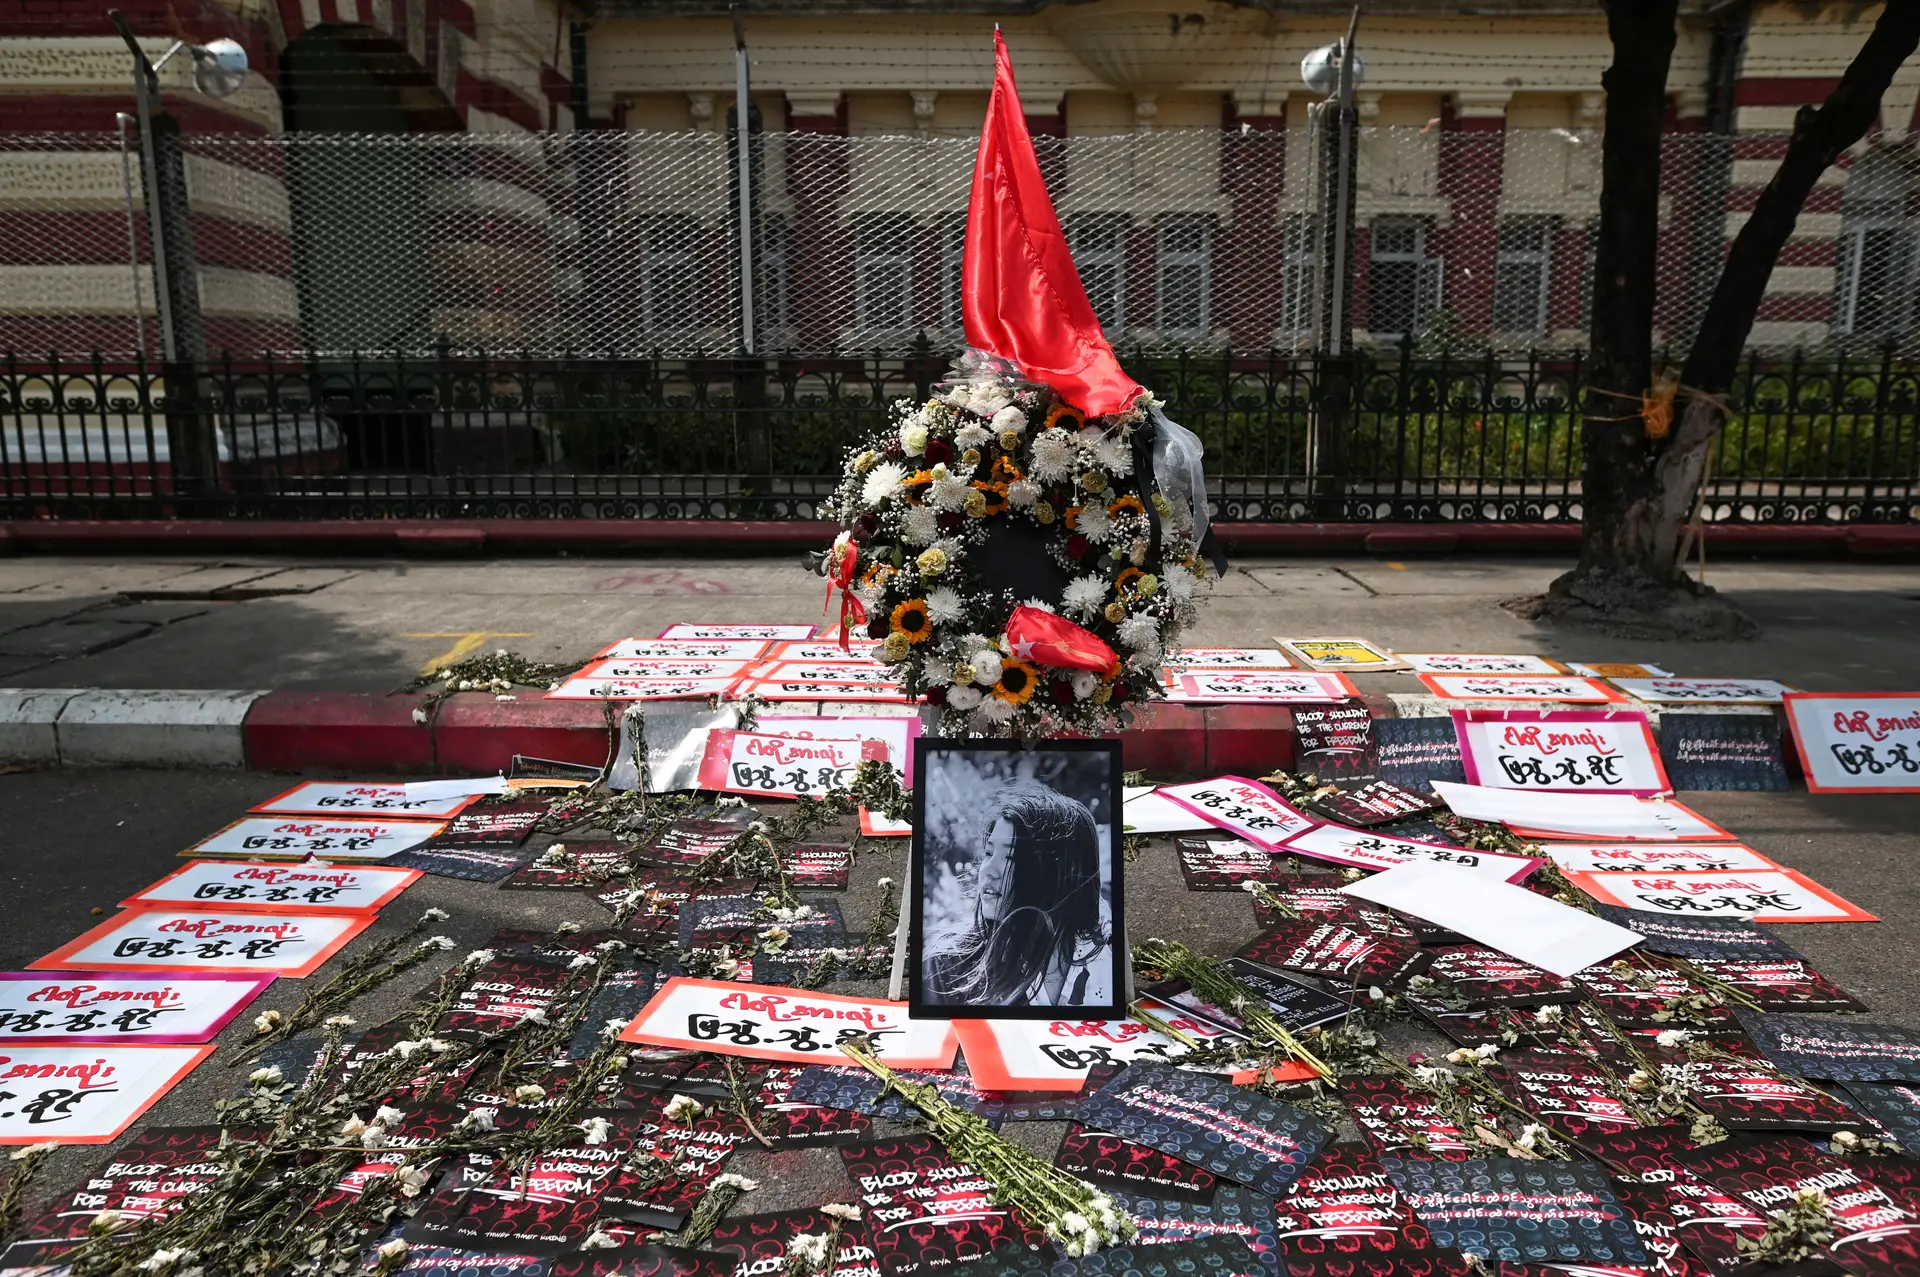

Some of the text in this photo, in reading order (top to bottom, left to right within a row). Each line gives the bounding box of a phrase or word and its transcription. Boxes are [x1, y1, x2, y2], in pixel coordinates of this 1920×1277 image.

[1295, 711, 1324, 724] BLOOD
[1296, 719, 1372, 735] BE THE CURRENCY
[1301, 737, 1319, 748] FOR
[459, 815, 493, 823] BLOOD
[470, 981, 516, 993] BLOOD
[460, 991, 510, 1003] BE THE
[1517, 1072, 1573, 1083] BLOOD
[1706, 1072, 1738, 1080] THE
[1520, 1081, 1548, 1093] BE
[1558, 1085, 1591, 1097] THE
[1530, 1094, 1567, 1110] FOR
[1360, 1117, 1430, 1129] BE THE
[103, 1162, 169, 1178] BLOOD
[468, 1152, 618, 1181] BE CURRENCY
[86, 1178, 160, 1193] BE THE
[860, 1170, 918, 1193] BLOOD
[862, 1192, 893, 1207] BE
[903, 1186, 938, 1201] THE
[1670, 1184, 1708, 1197] THE
[1741, 1185, 1794, 1208] BLOOD
[72, 1192, 108, 1208] FOR
[1286, 1190, 1397, 1209] THE CURRENCY
[873, 1206, 912, 1222] FOR
[457, 1228, 478, 1237] MYA
